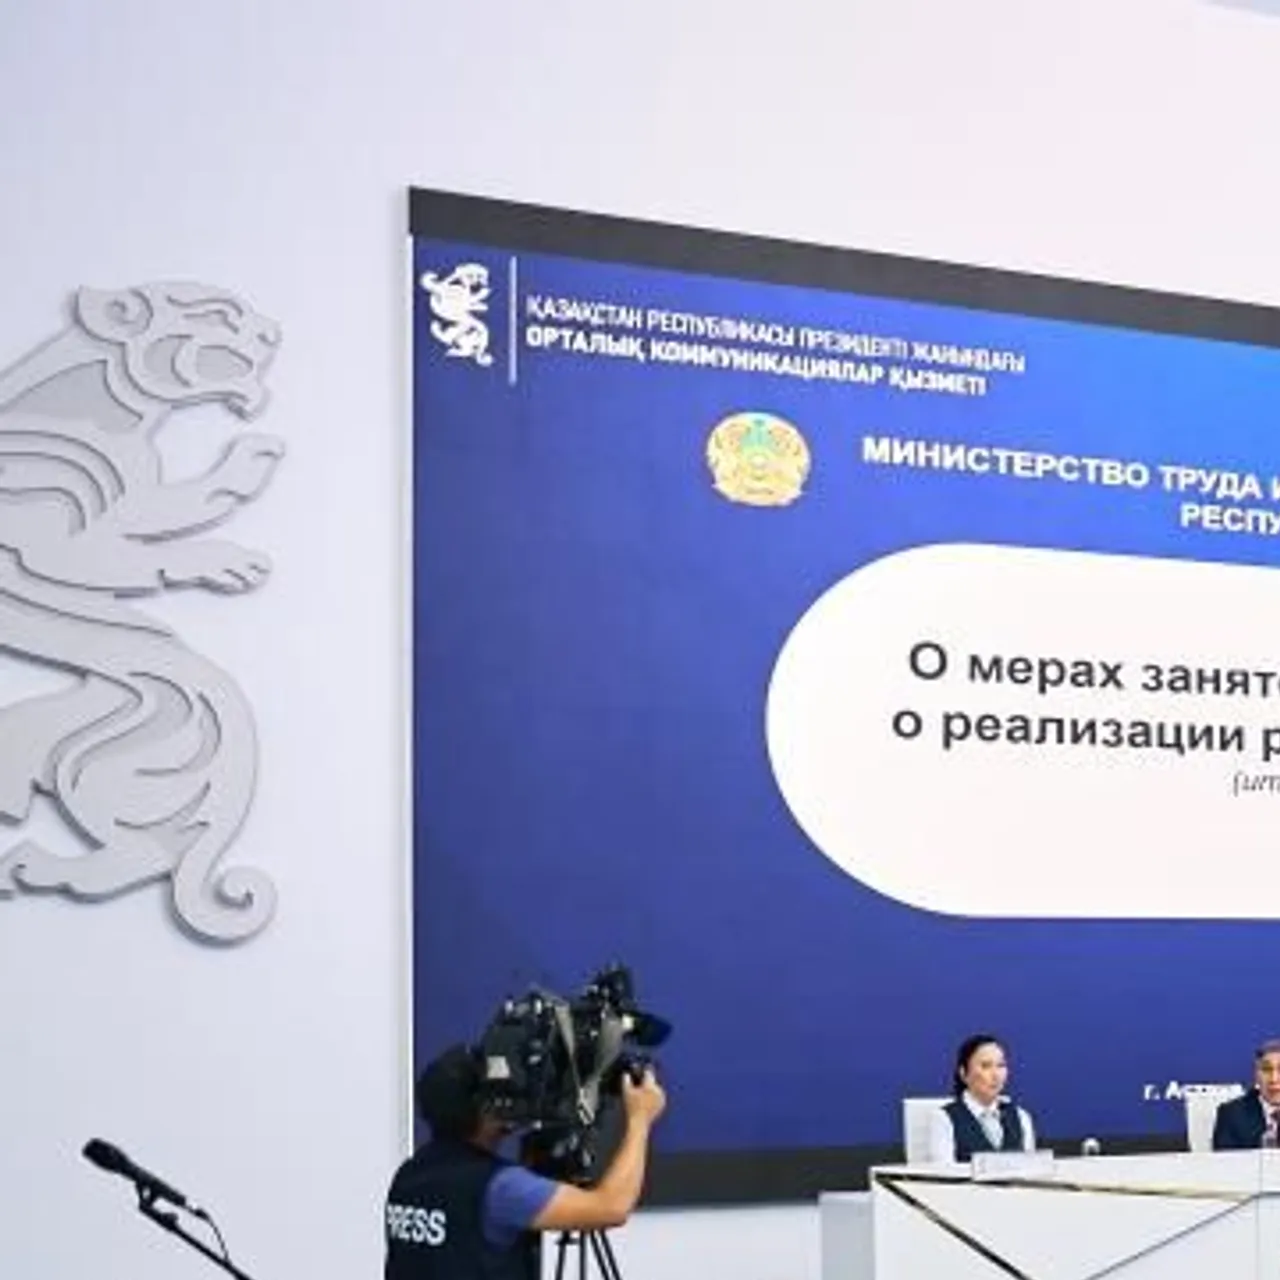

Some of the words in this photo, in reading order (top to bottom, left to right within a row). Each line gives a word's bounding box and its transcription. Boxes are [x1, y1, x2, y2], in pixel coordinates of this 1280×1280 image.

[526, 295, 643, 329] ҚАЗАҚСТАН
[647, 308, 794, 347] РЕСПУБЛИКАСЫ
[526, 324, 645, 362] ОРТАЛЫҚ
[650, 338, 884, 384] КОММУНИКАЦИЯЛАР
[862, 435, 1149, 488] МИНИСТЕРСТВО
[1158, 464, 1263, 500] ТРУДА
[908, 640, 949, 681] О
[968, 652, 1125, 695] мерах
[892, 709, 924, 740] о
[941, 710, 1246, 756] реализации
